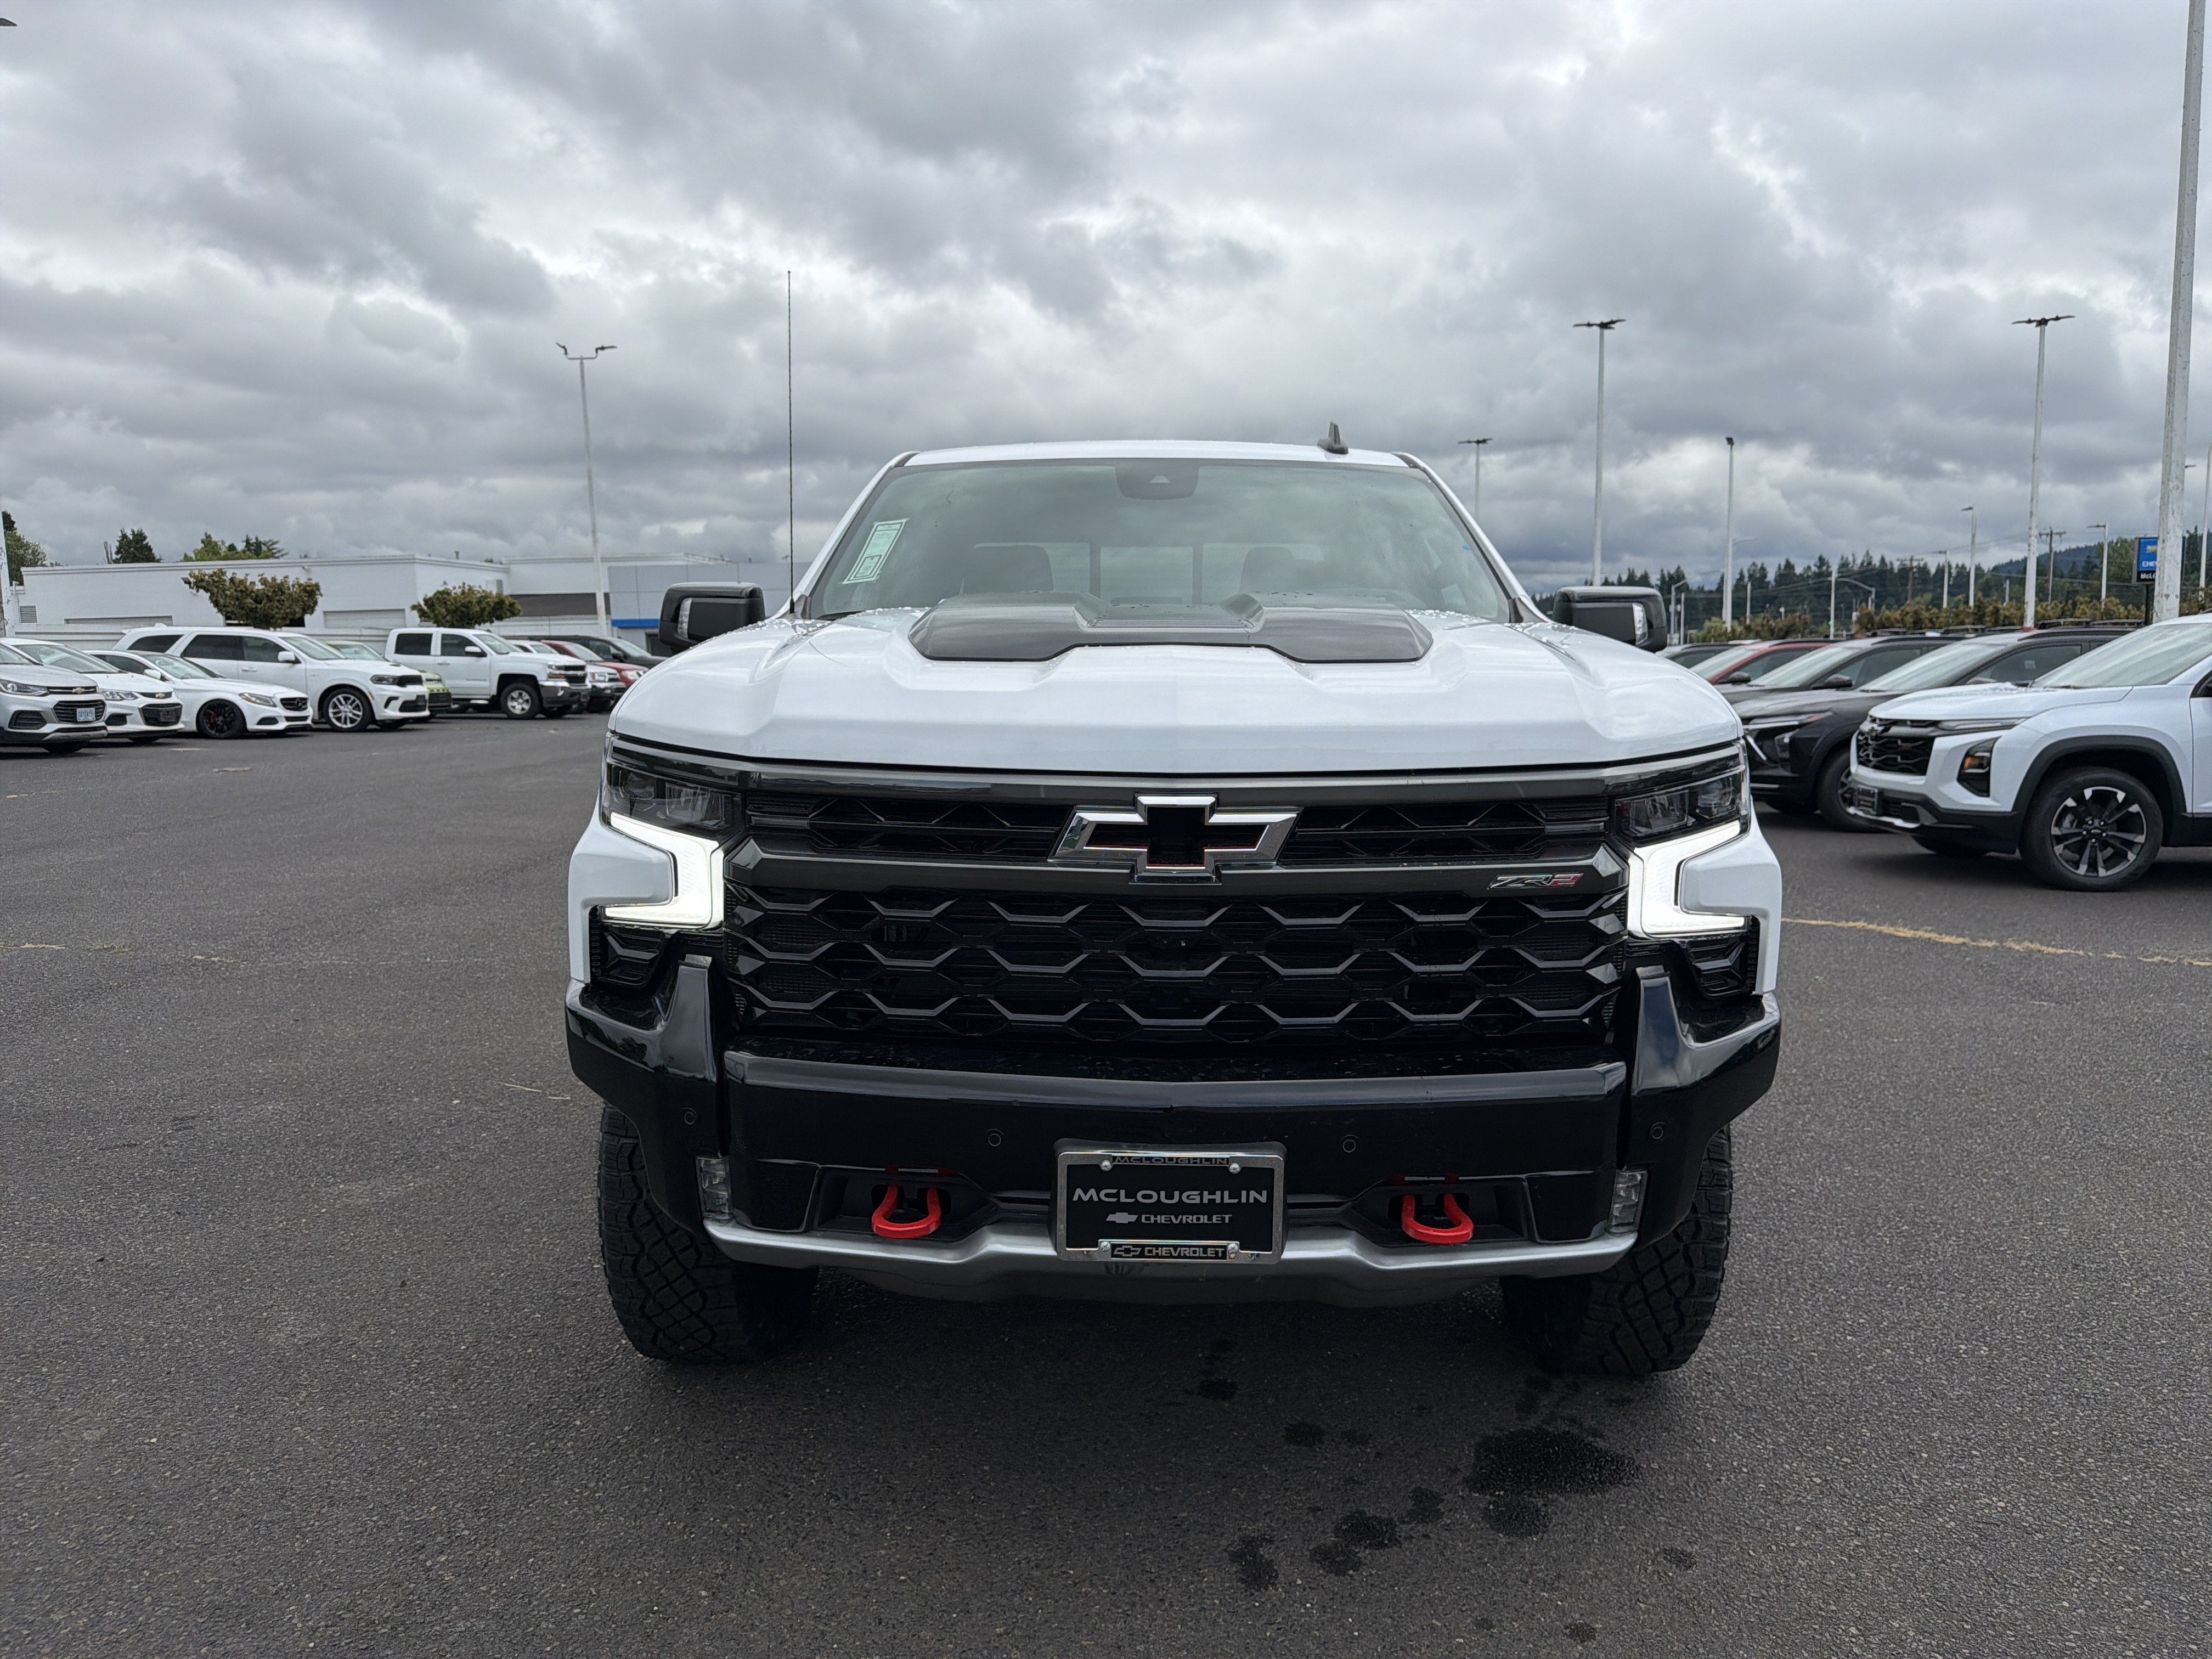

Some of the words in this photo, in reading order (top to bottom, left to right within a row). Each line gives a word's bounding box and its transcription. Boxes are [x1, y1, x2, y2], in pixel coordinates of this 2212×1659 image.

[1487, 873, 1584, 890] ZR2
[1073, 1188, 1267, 1204] MCLOUGHLIN
[1142, 1214, 1232, 1224] CHEVROLET
[1144, 1248, 1224, 1257] CHEVROLET
